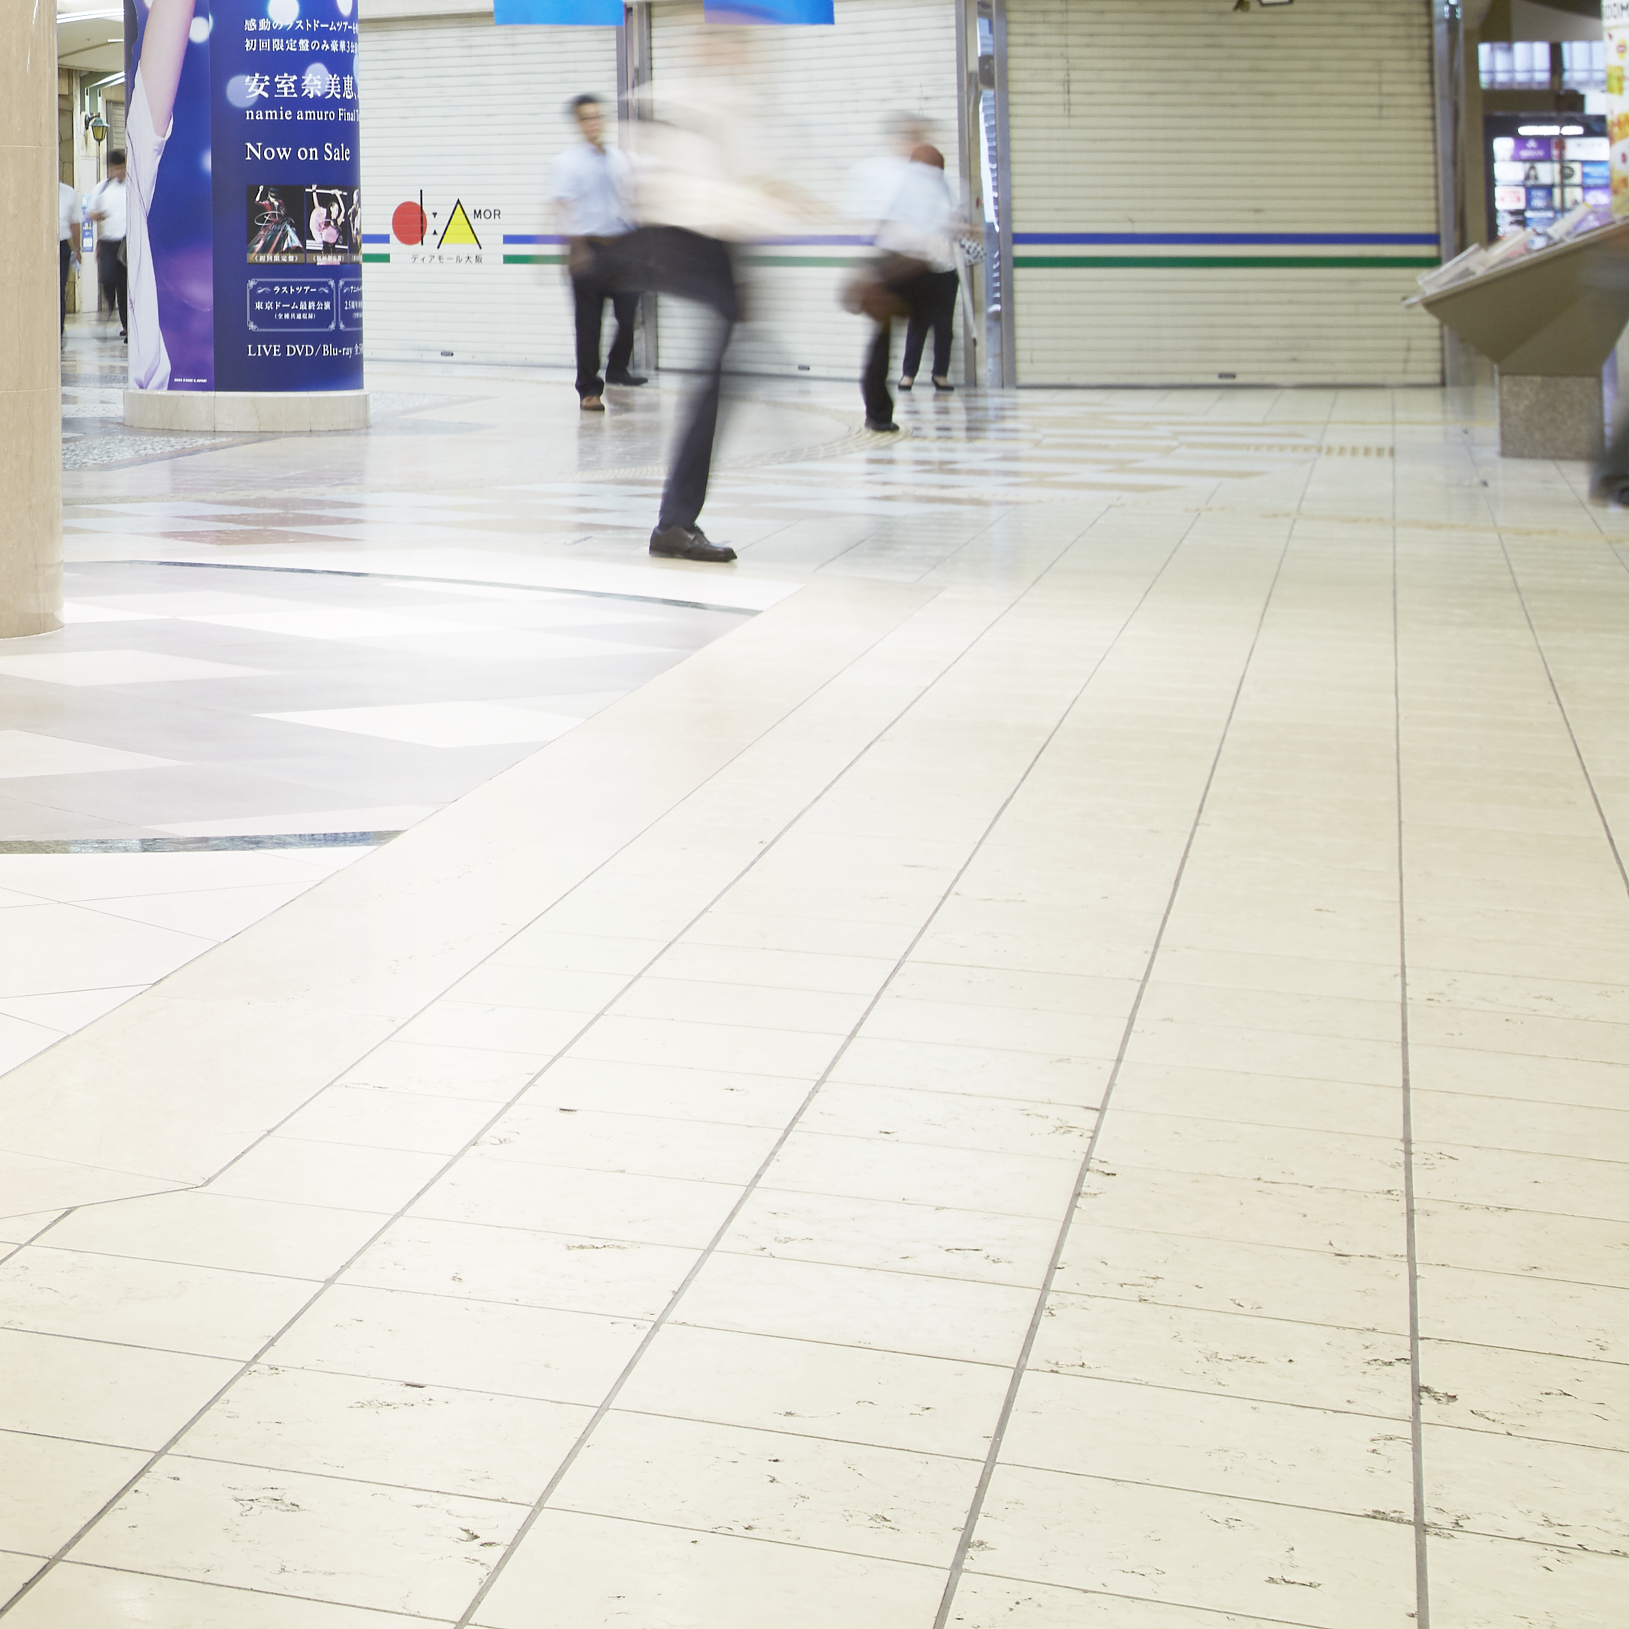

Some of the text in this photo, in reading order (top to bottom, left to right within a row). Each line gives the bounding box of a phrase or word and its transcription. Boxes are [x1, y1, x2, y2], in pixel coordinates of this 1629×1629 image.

[245, 106, 293, 120] namie
[296, 109, 336, 121] amuro
[338, 108, 356, 122] Final
[245, 142, 351, 161] Now on Sale
[411, 254, 483, 264] ディアモール大阪
[273, 285, 317, 294] ラストツアー
[254, 300, 331, 311] 東京ドーム最終公演
[247, 344, 281, 356] LIVE
[286, 343, 353, 359] DVD/Blu-ray
